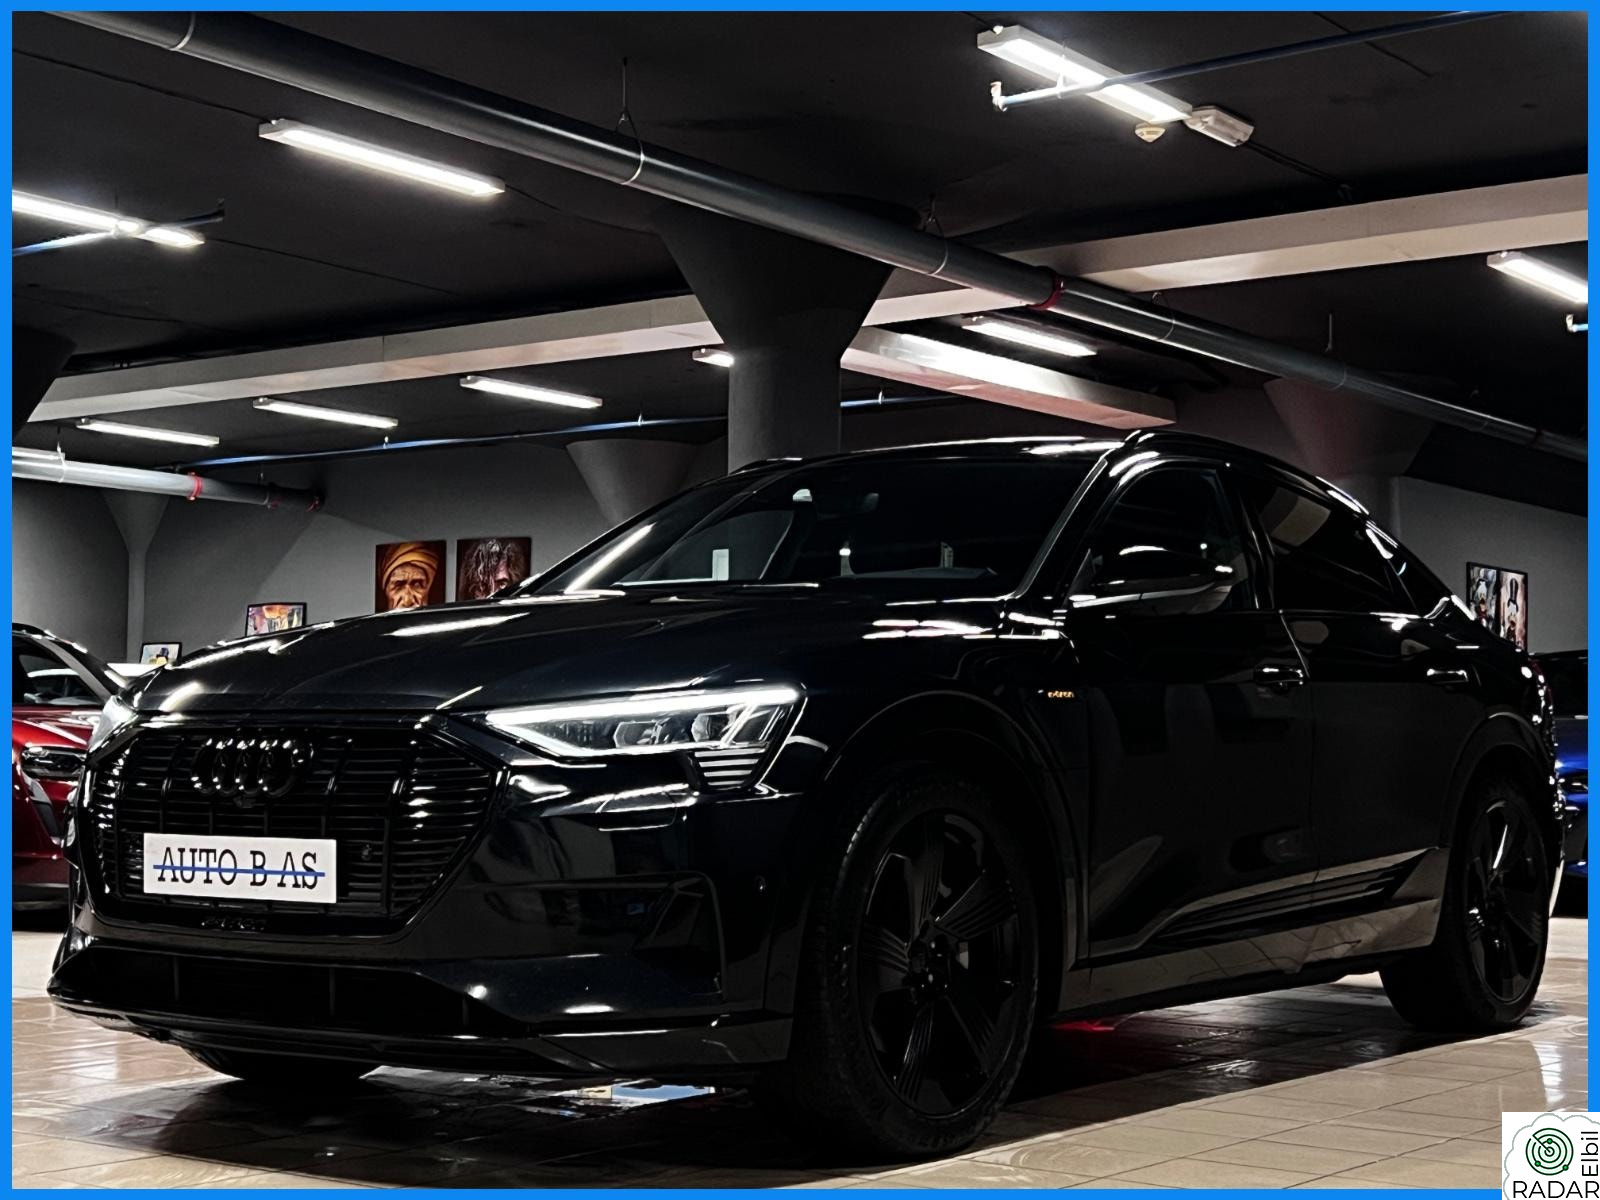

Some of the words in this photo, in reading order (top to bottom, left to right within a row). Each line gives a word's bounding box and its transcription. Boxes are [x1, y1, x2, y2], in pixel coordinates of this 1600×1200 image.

[157, 846, 238, 886] AUTO
[249, 850, 268, 887] B
[276, 851, 318, 890] AS
